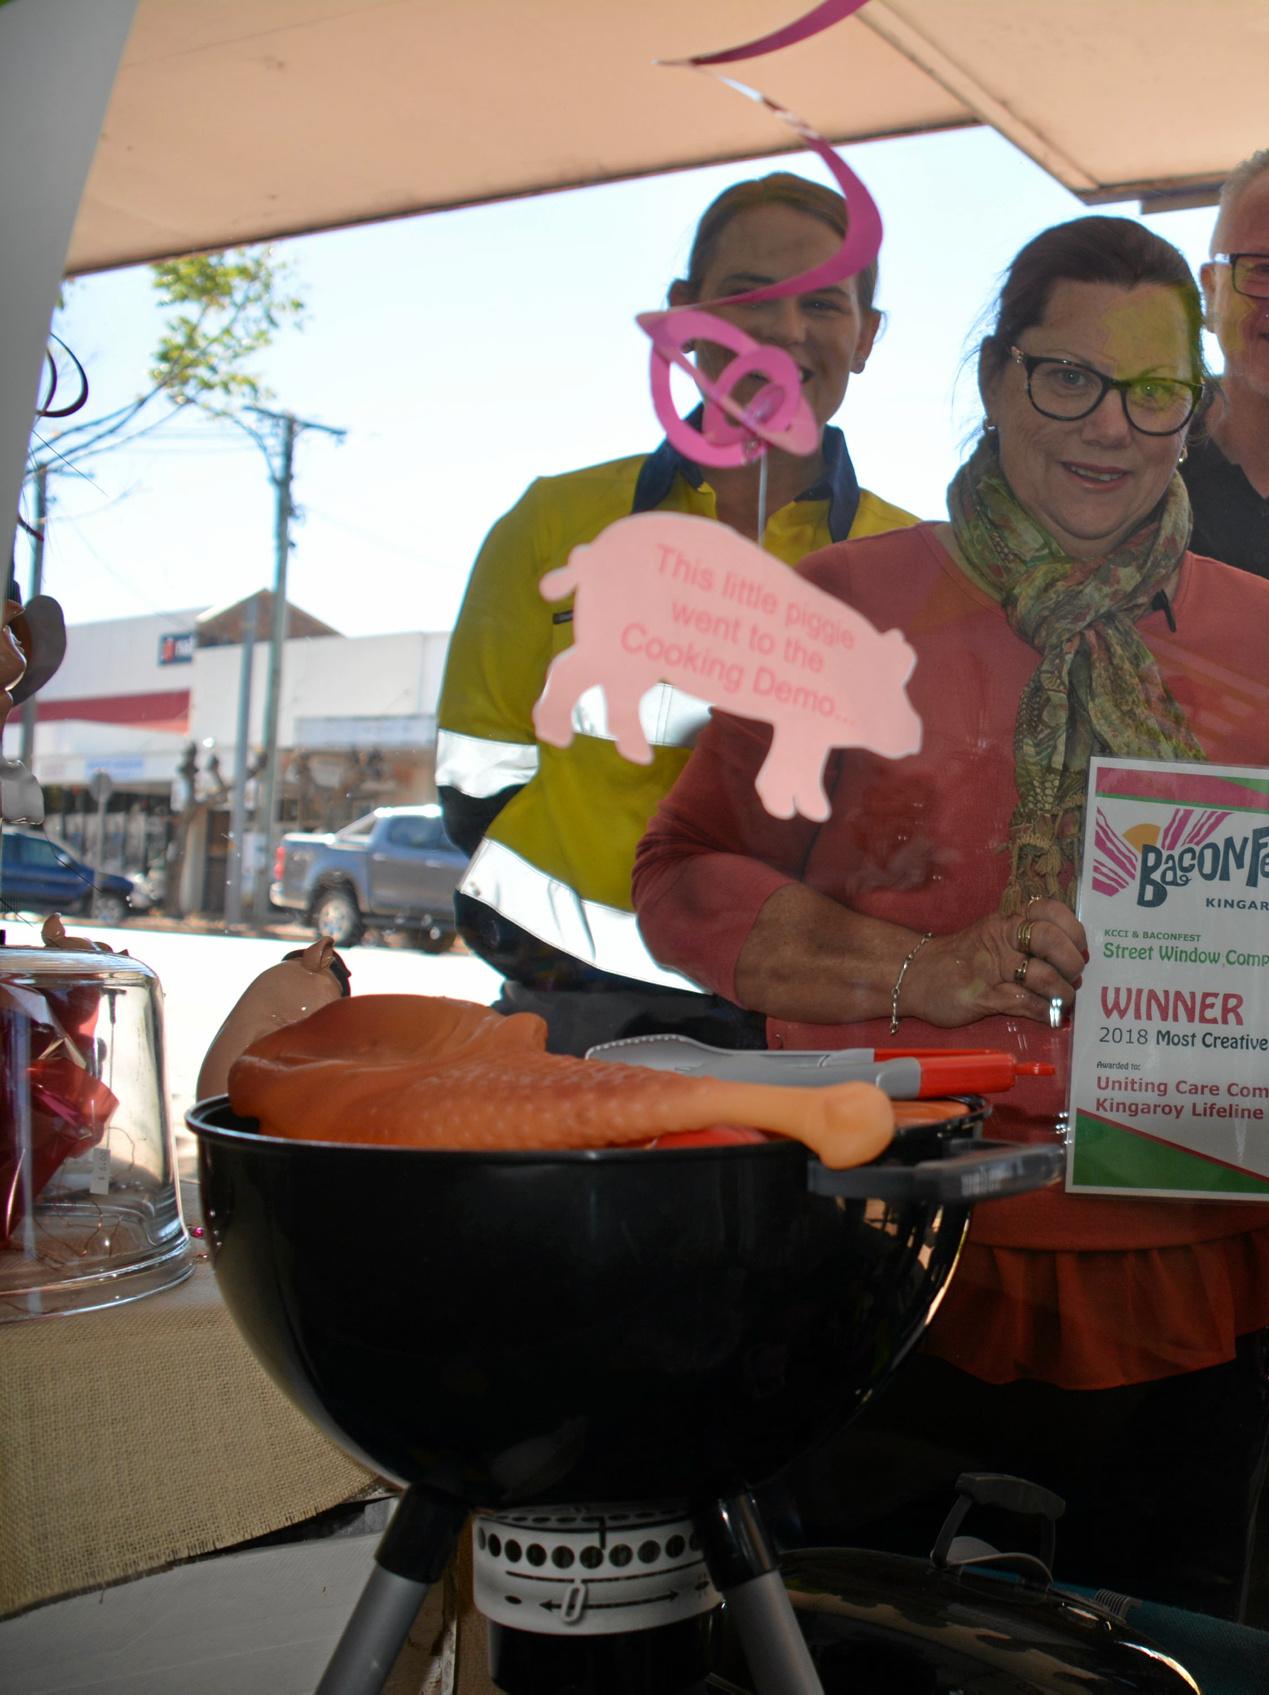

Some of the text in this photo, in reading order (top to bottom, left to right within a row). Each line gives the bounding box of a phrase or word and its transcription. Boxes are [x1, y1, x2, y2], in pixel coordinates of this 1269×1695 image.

[658, 544, 857, 651] This little piggie
[671, 601, 825, 673] went to the
[620, 622, 745, 695] Cooking
[1104, 929, 1202, 942] KCCI & BACONFEST
[1103, 942, 1154, 960] Street
[1159, 945, 1221, 965] Window
[1100, 986, 1244, 1025] WINNER
[1099, 1027, 1148, 1045] 2018
[1156, 1030, 1197, 1047] Most
[1201, 1032, 1269, 1051] Creative
[1096, 1061, 1129, 1071] Awarded
[1097, 1076, 1168, 1097] Uniting
[1175, 1080, 1220, 1096] Care
[1096, 1098, 1264, 1120] Kingaroy Lifeline
